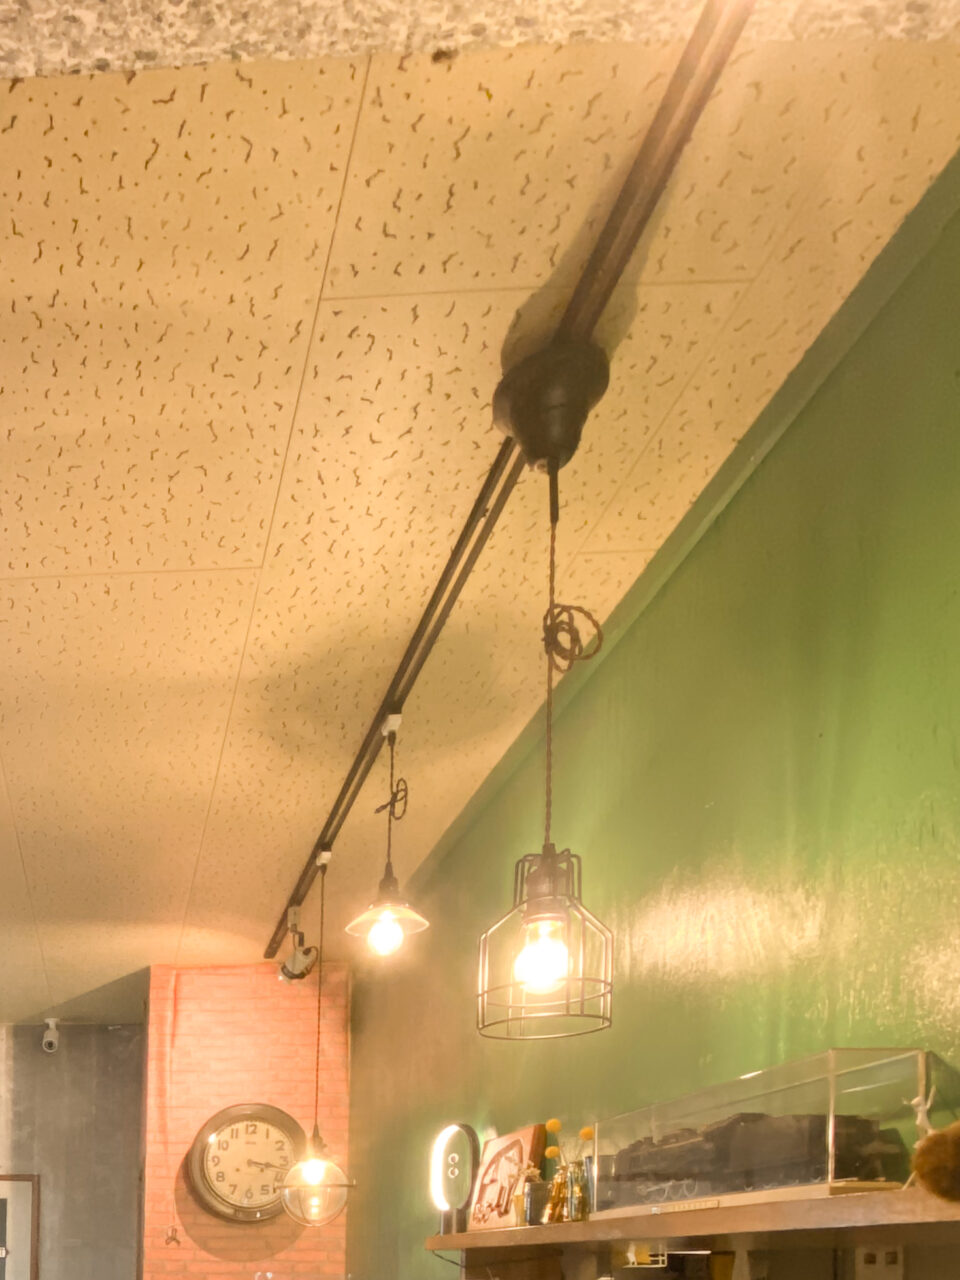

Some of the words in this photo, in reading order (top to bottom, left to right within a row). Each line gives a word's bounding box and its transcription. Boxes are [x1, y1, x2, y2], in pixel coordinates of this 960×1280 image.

[231, 1128, 239, 1139] 11
[245, 1123, 258, 1135] 12
[266, 1128, 270, 1139] 1
[217, 1140, 229, 1151] 10
[275, 1140, 285, 1151] 2
[211, 1155, 220, 1167] 9
[279, 1156, 289, 1167] 3
[216, 1171, 225, 1182] 8
[228, 1184, 237, 1195] 7
[244, 1185, 254, 1199] 6
[260, 1184, 270, 1195] 5
